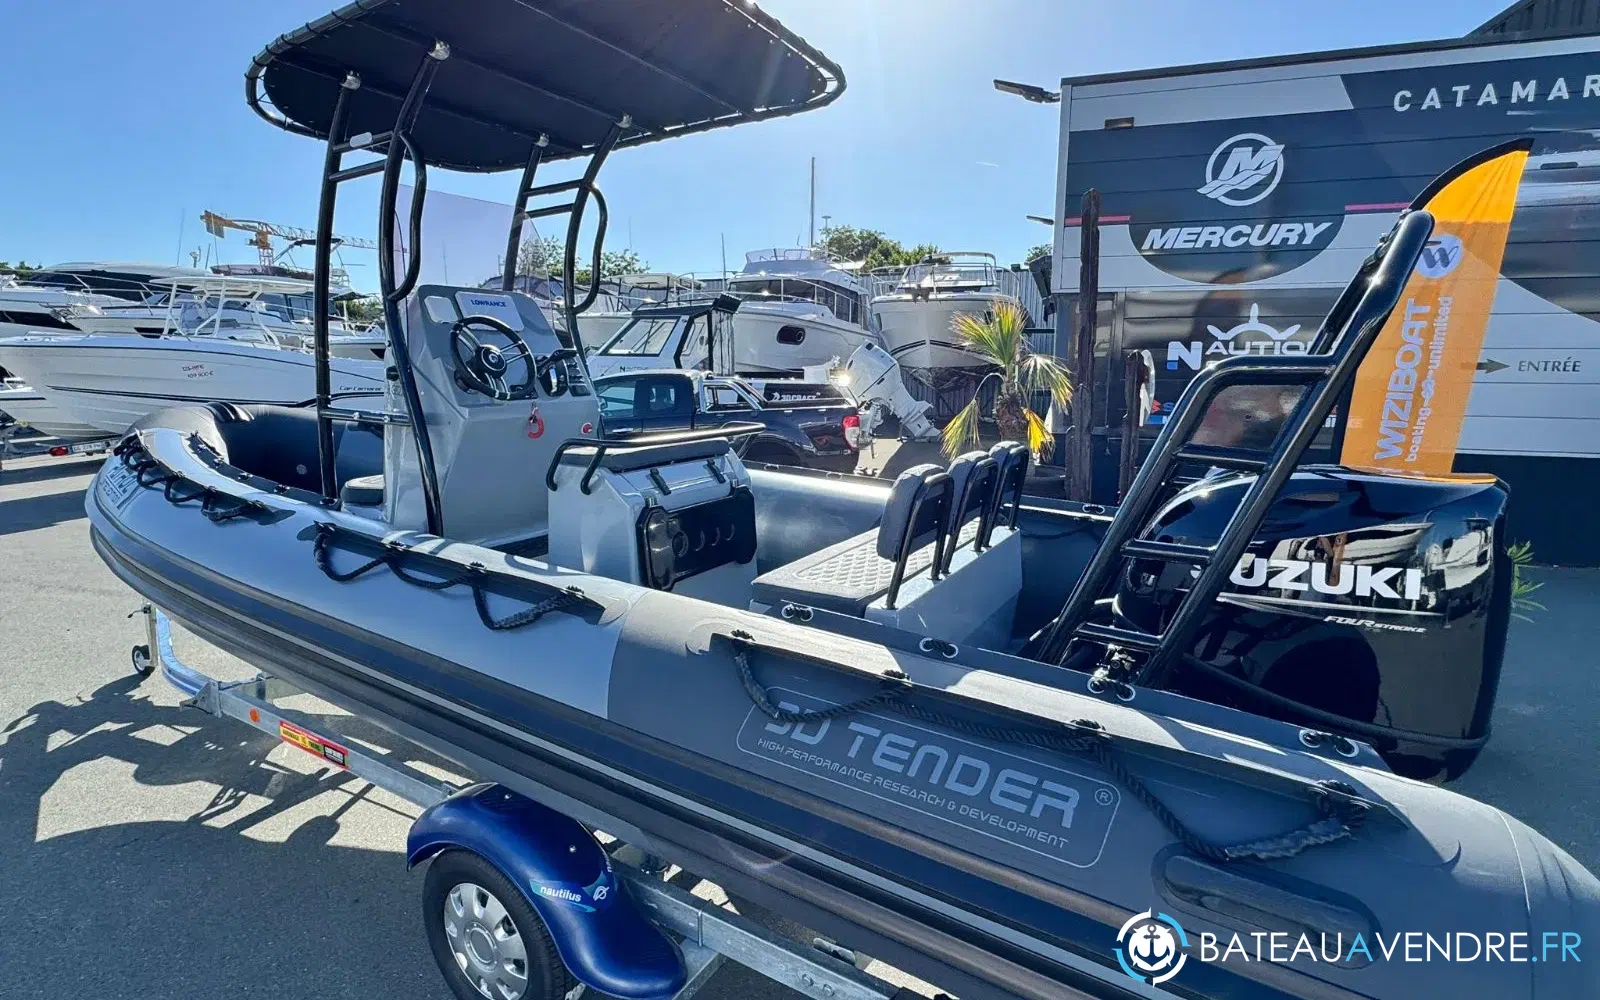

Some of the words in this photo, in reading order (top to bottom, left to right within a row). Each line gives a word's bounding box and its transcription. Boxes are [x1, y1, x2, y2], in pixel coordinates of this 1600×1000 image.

[1393, 74, 1600, 112] CATAMAR
[1141, 222, 1333, 250] MERCURY
[470, 299, 507, 308] LOWRANCE
[1374, 298, 1431, 460] WIZIBOAT
[1518, 357, 1582, 373] ENTRÉE
[847, 721, 1080, 829] TENDER
[757, 738, 785, 754] HIGH
[786, 748, 873, 782] PERFORMANCE
[873, 775, 946, 807] RESEARCH
[959, 804, 1069, 850] DEVELOPMENT
[540, 886, 582, 902] nautilus
